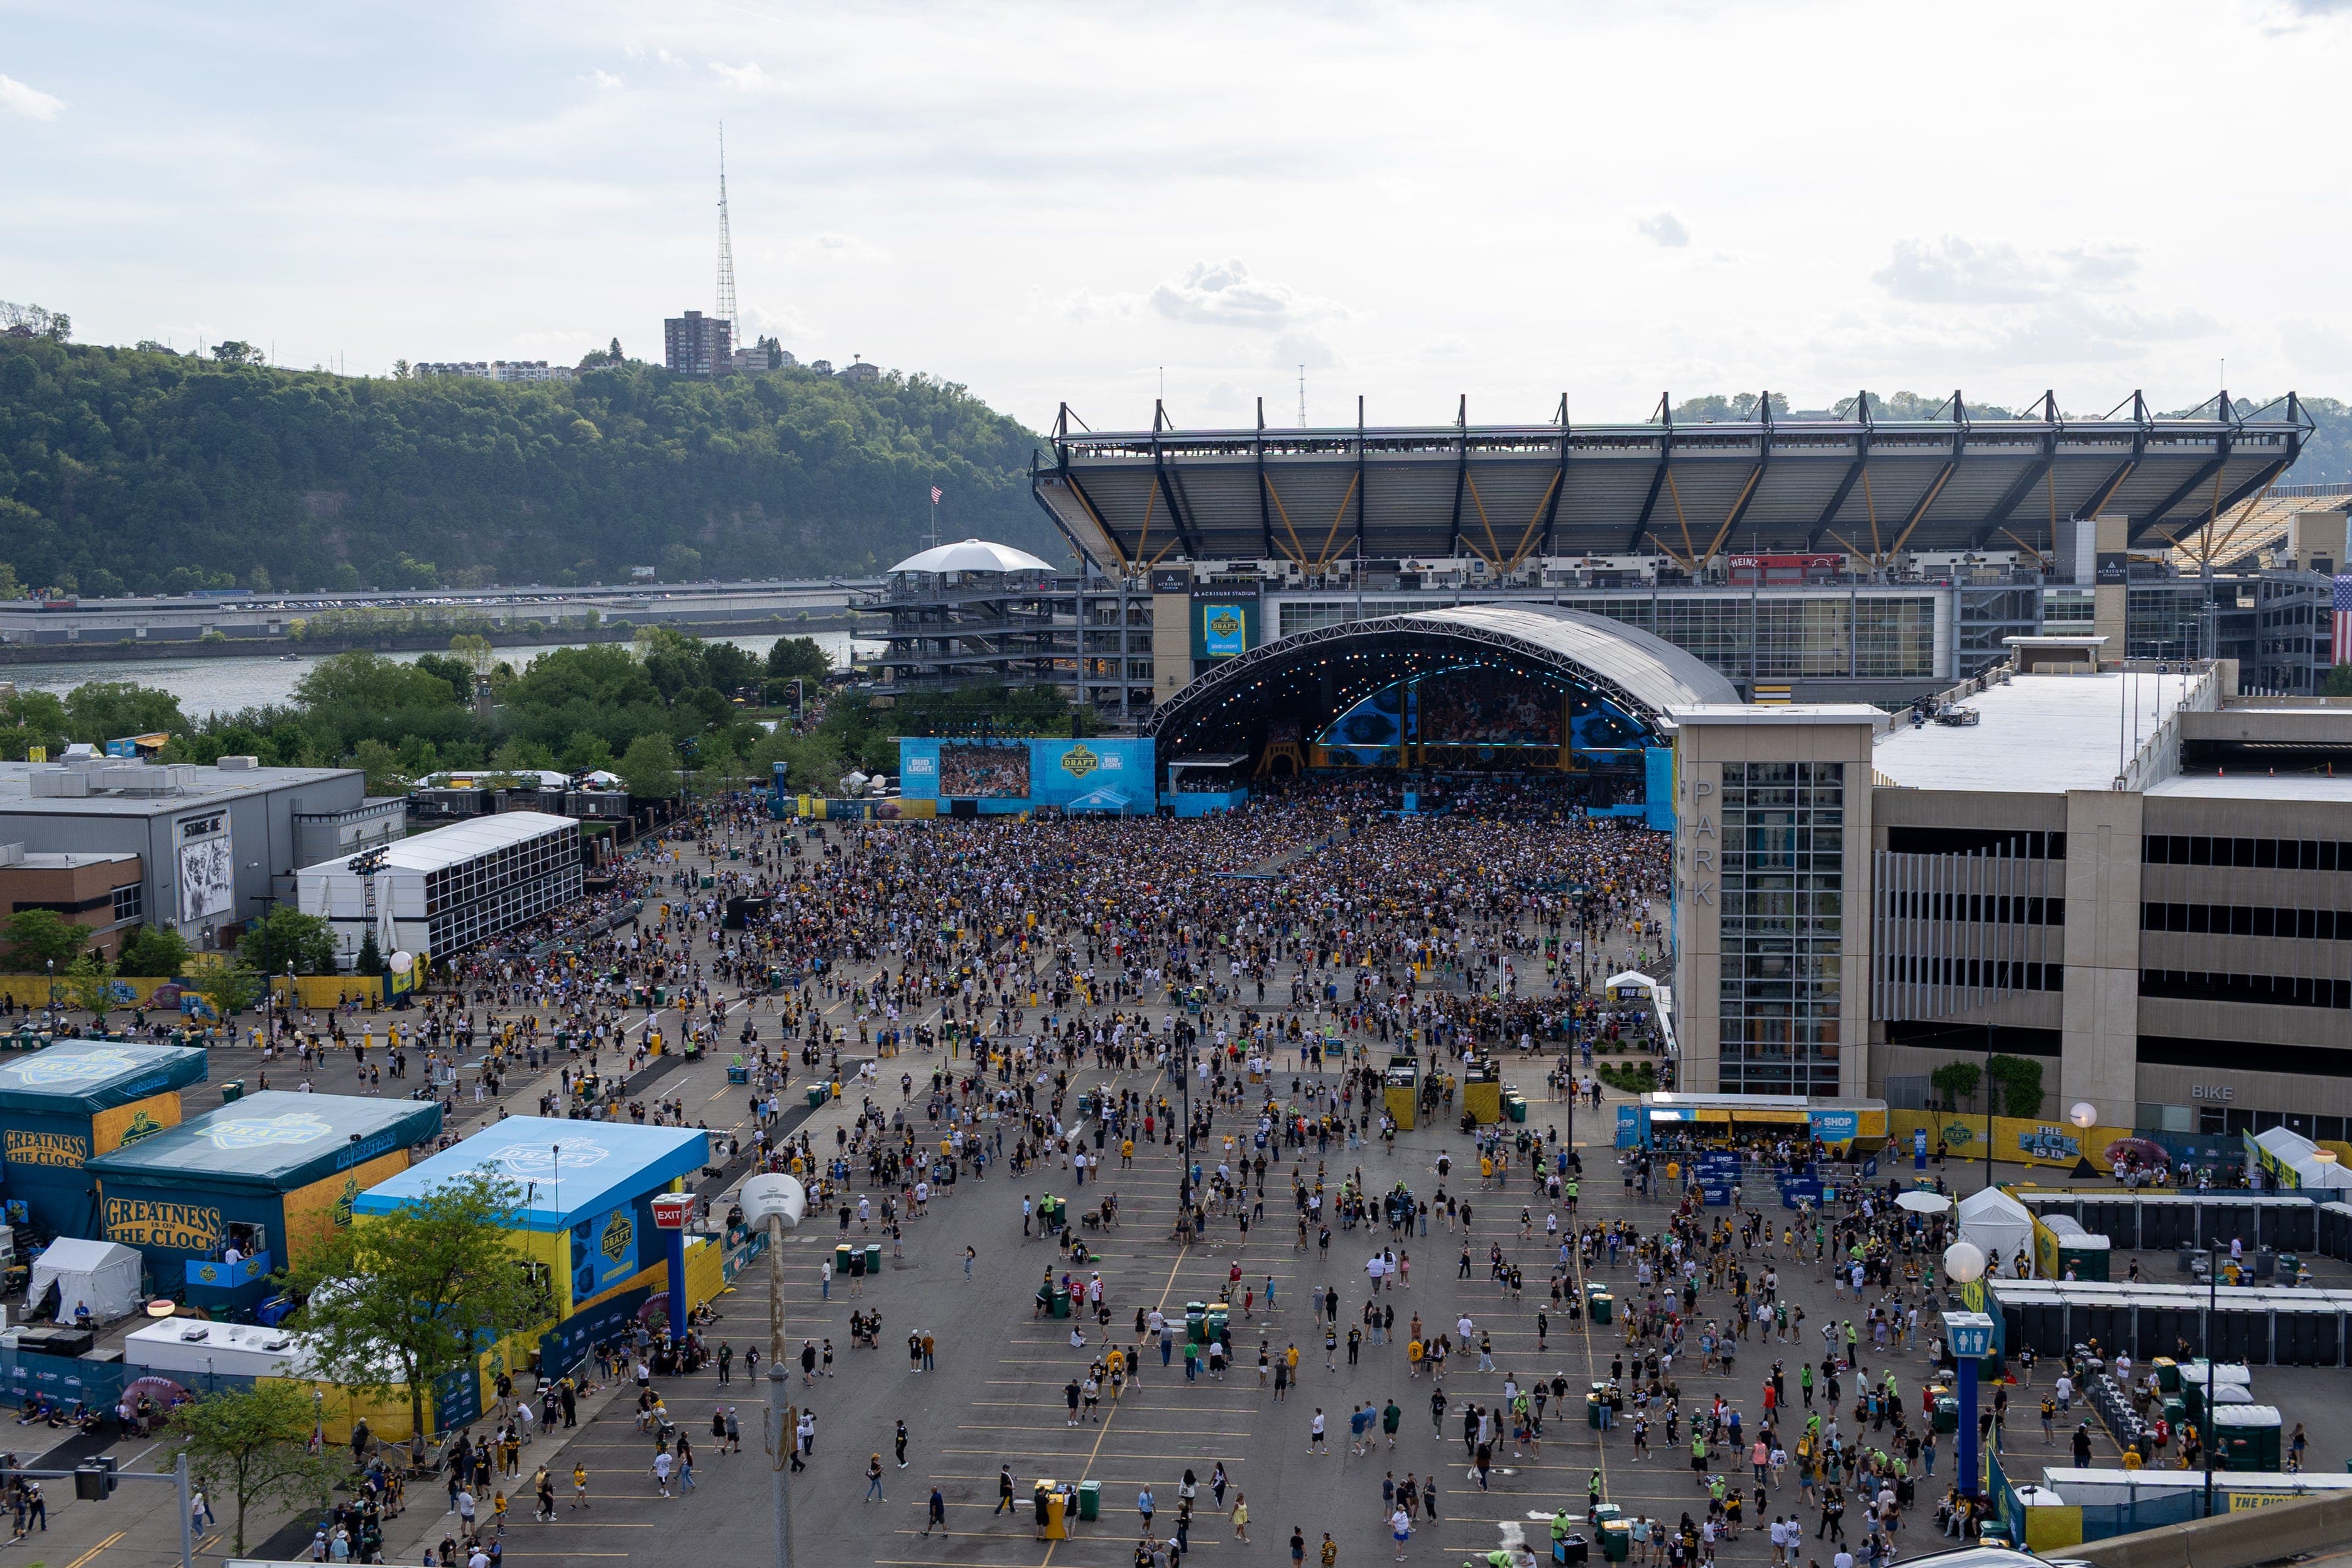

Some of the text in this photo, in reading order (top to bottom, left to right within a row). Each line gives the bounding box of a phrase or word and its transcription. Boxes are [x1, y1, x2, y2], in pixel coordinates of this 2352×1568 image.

[1523, 707, 1532, 716] 17
[184, 820, 209, 837] STAGE
[1693, 780, 1716, 906] PARK
[26, 1062, 117, 1074] DRAFT
[2192, 1084, 2233, 1100] BIKE
[1824, 1117, 1851, 1126] SHOP
[213, 1126, 315, 1138] DRAFT
[2037, 1126, 2063, 1135] THE
[5, 1130, 87, 1158] GREATNESS
[353, 1141, 378, 1158] DRAFT
[2018, 1133, 2081, 1155] PICK
[504, 1149, 595, 1163] DRAFT
[2033, 1147, 2066, 1160] IS IN
[6, 1152, 85, 1168] THE CLOCK
[105, 1199, 220, 1237] GREATNESS
[657, 1211, 681, 1220] EXIT
[684, 1206, 694, 1218] EXIT
[107, 1228, 217, 1251] THE CLOCK
[604, 1229, 629, 1249] DRAFT
[1073, 1288, 1079, 1296] 21
[2022, 1353, 2030, 1361] 32
[1636, 1393, 1646, 1402] 20
[2235, 1497, 2258, 1508] THE
[1788, 1531, 1795, 1539] 90
[1683, 1537, 1694, 1547] 86
[1675, 1549, 1682, 1557] 10
